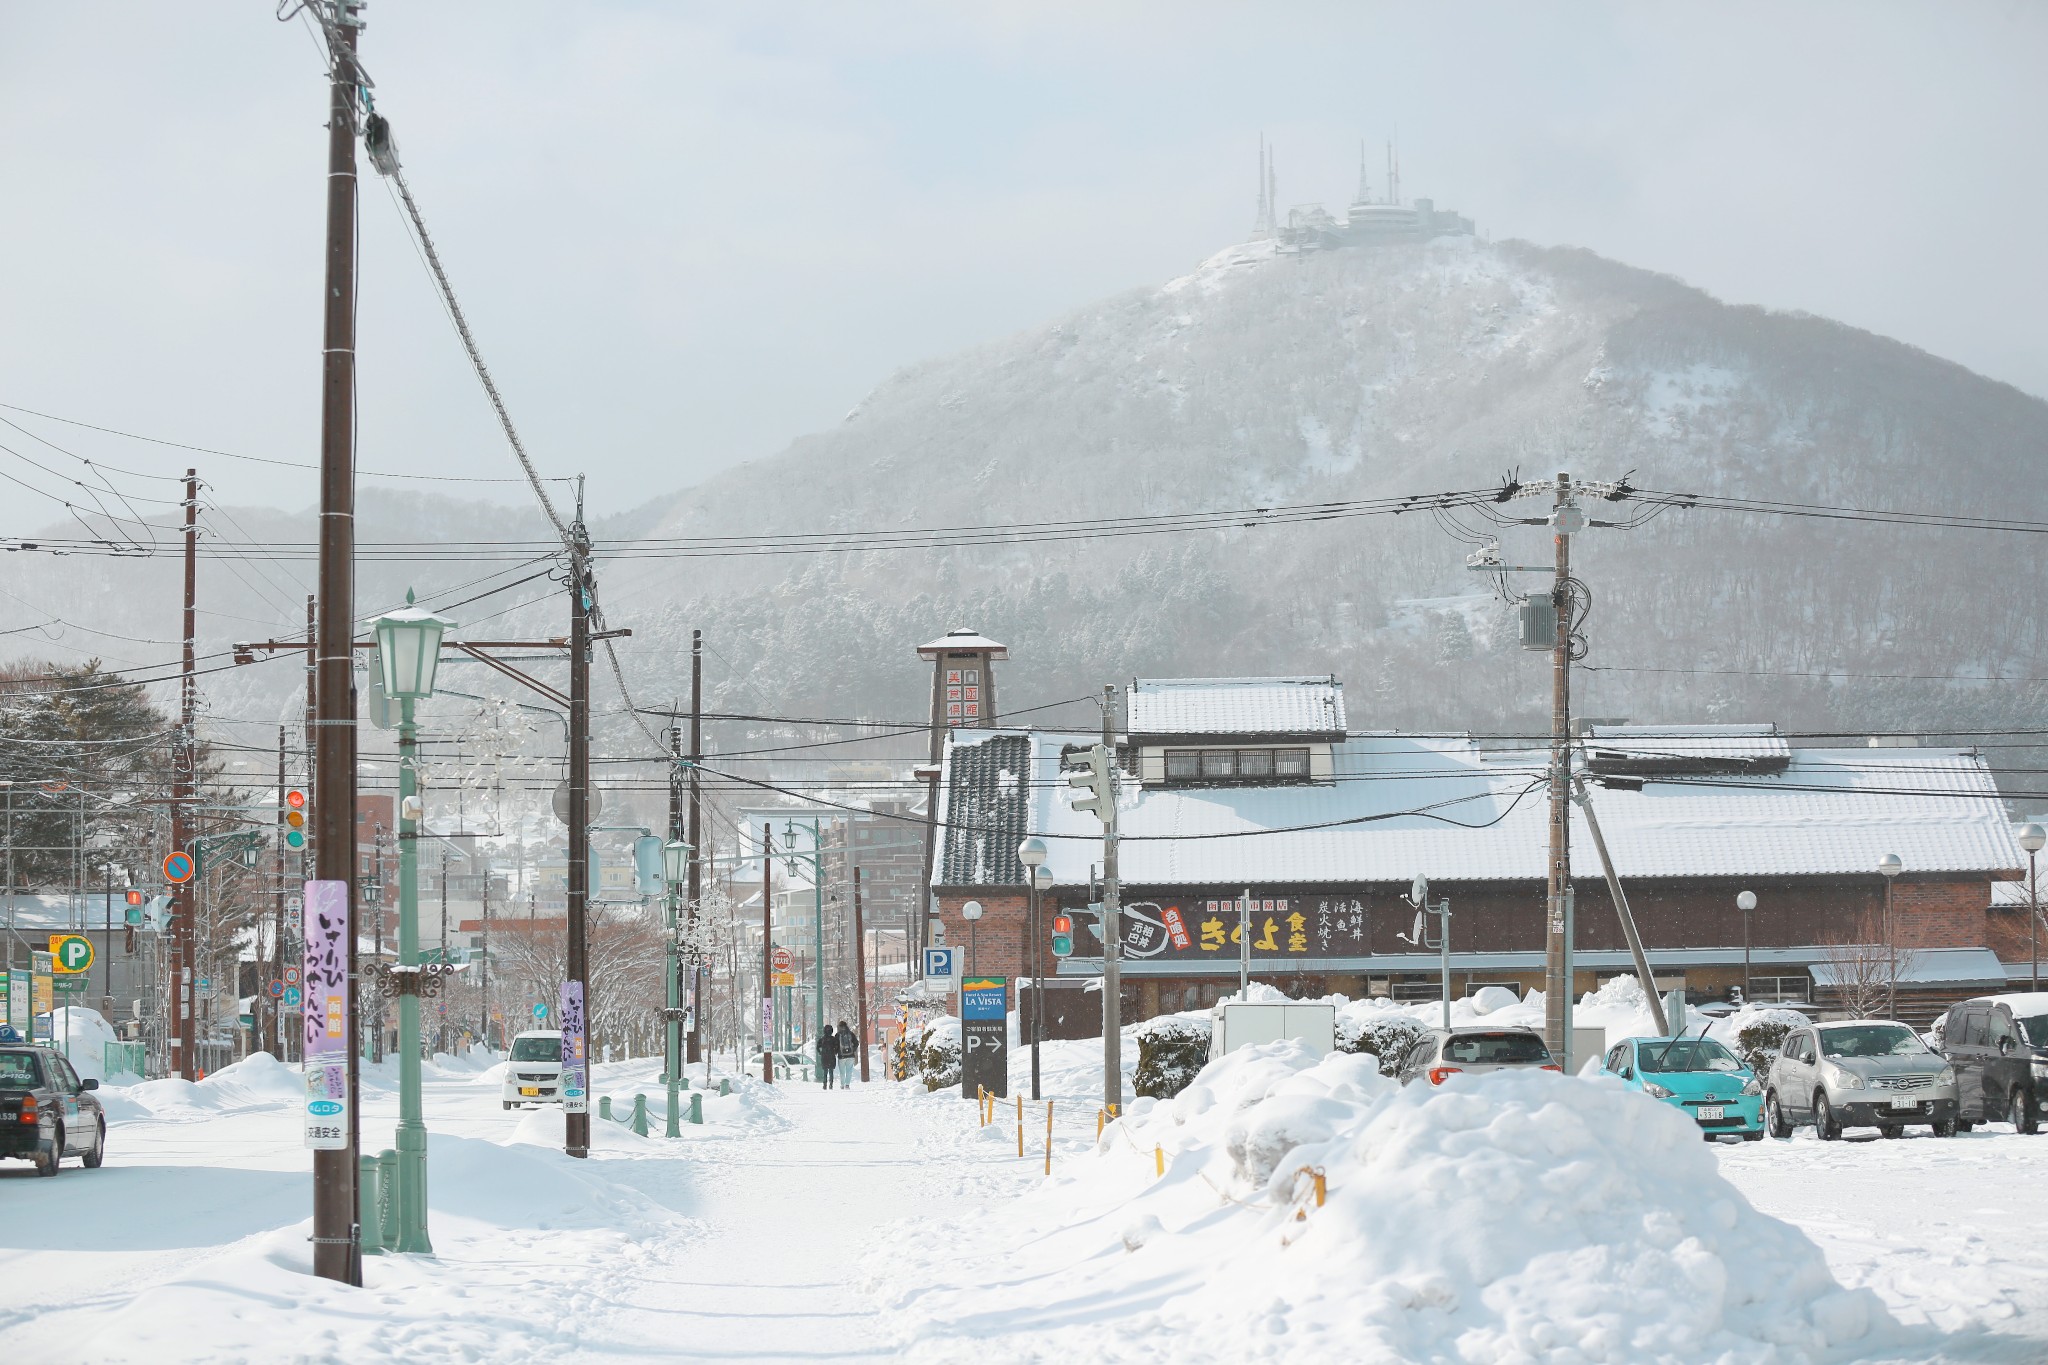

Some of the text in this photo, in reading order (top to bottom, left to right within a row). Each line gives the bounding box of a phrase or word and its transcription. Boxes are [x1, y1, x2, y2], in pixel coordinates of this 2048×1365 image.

[1318, 901, 1331, 950] 炭火焼き
[1335, 902, 1347, 931] 活魚
[1350, 900, 1363, 941] 海鮮丼
[1132, 922, 1154, 938] 元祖
[1285, 912, 1307, 951] 食堂
[68, 943, 86, 967] P
[930, 951, 948, 975] P
[966, 997, 1002, 1005] LA VISTA
[967, 1036, 981, 1053] P
[308, 1127, 341, 1138] 交通安全
